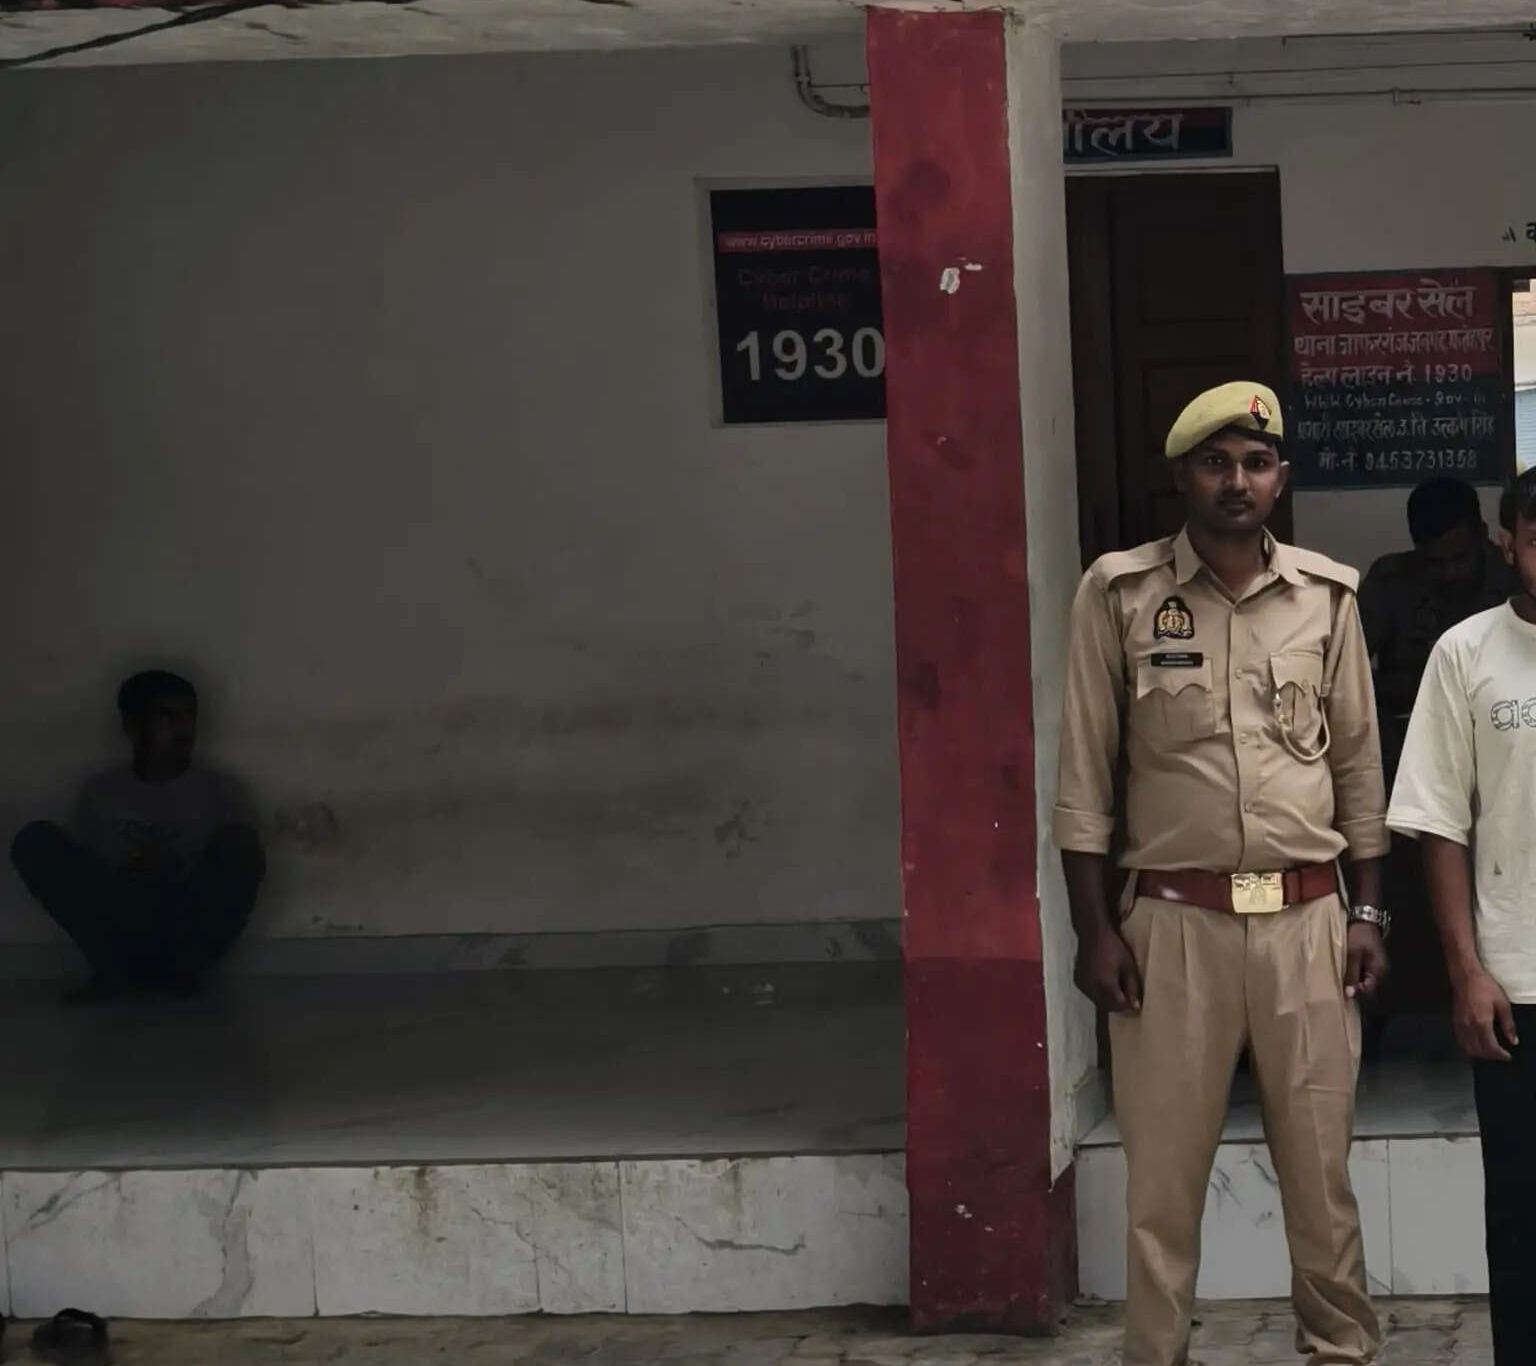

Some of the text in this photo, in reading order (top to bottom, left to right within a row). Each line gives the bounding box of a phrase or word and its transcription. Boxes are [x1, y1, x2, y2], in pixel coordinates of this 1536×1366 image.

[1299, 289, 1417, 325] साइबर
[736, 326, 886, 383] 1930
[1294, 334, 1336, 357] थाना
[1425, 363, 1473, 385] 1930
